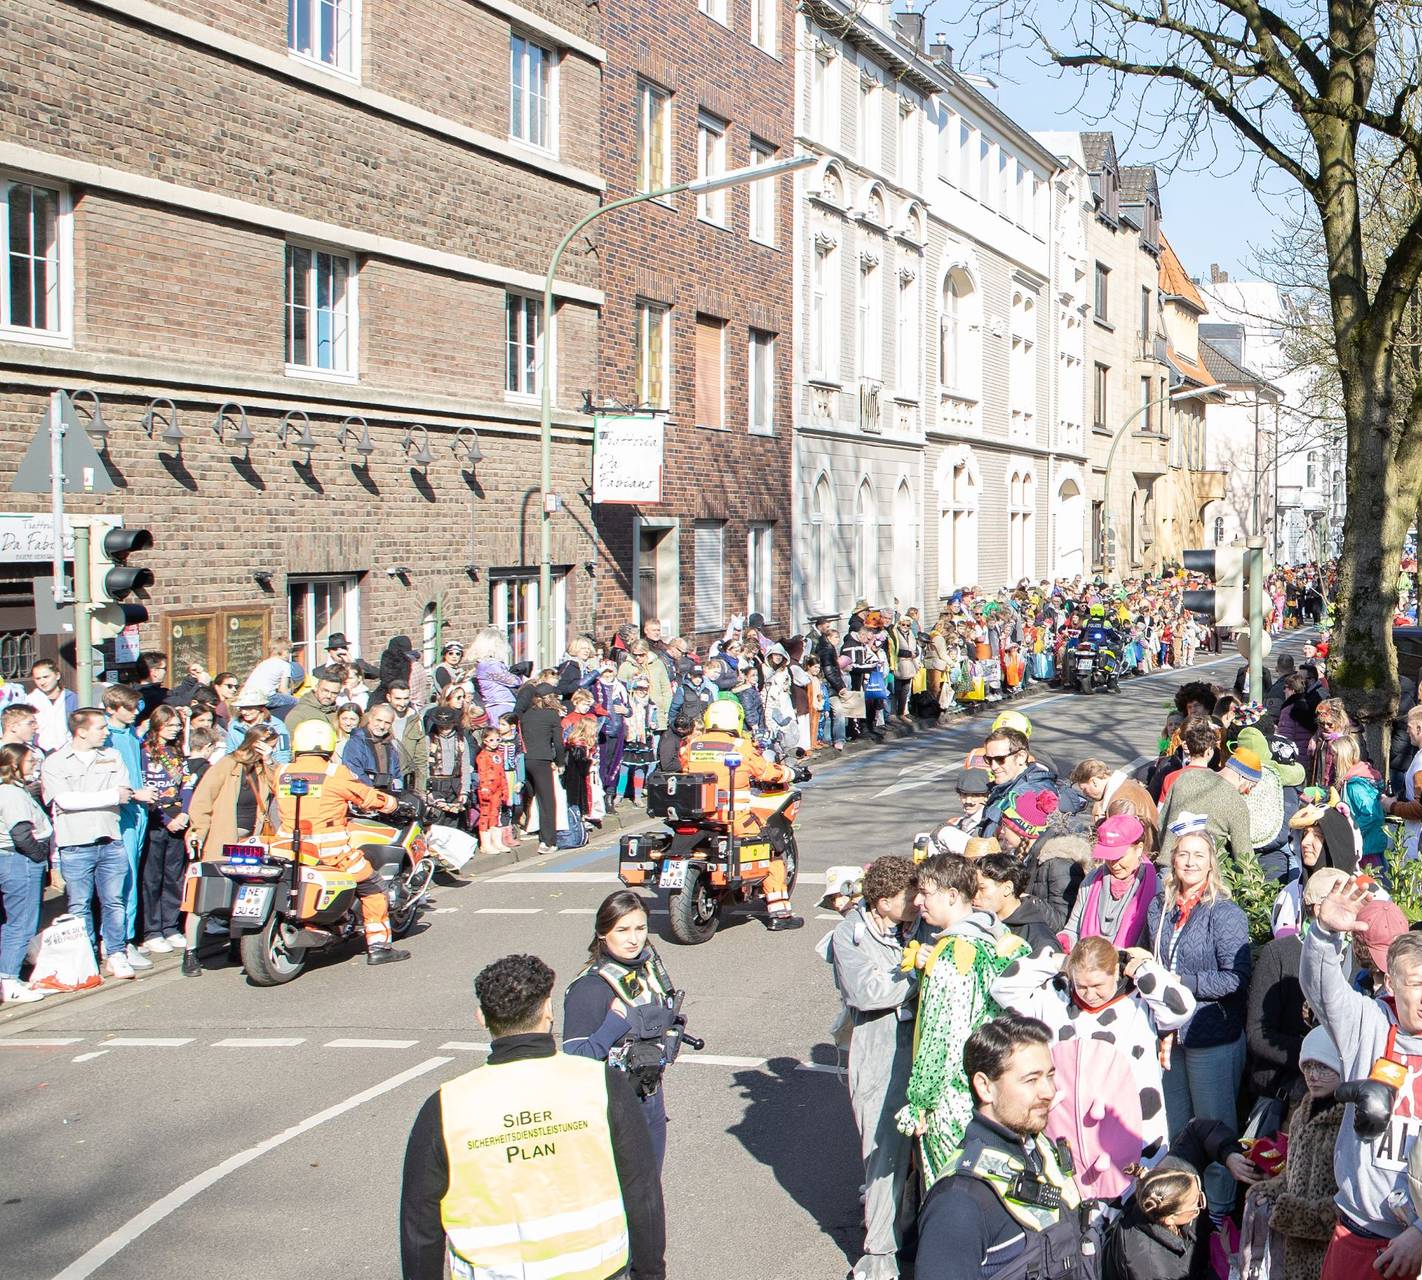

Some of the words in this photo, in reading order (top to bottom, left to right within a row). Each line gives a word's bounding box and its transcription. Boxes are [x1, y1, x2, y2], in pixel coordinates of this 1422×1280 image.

[2, 532, 21, 551] Da
[146, 779, 177, 788] ORAC
[670, 861, 681, 869] NE
[660, 878, 671, 887] JU
[466, 1120, 589, 1150] SICHERHEITSDIENSTLEISTUNGEN
